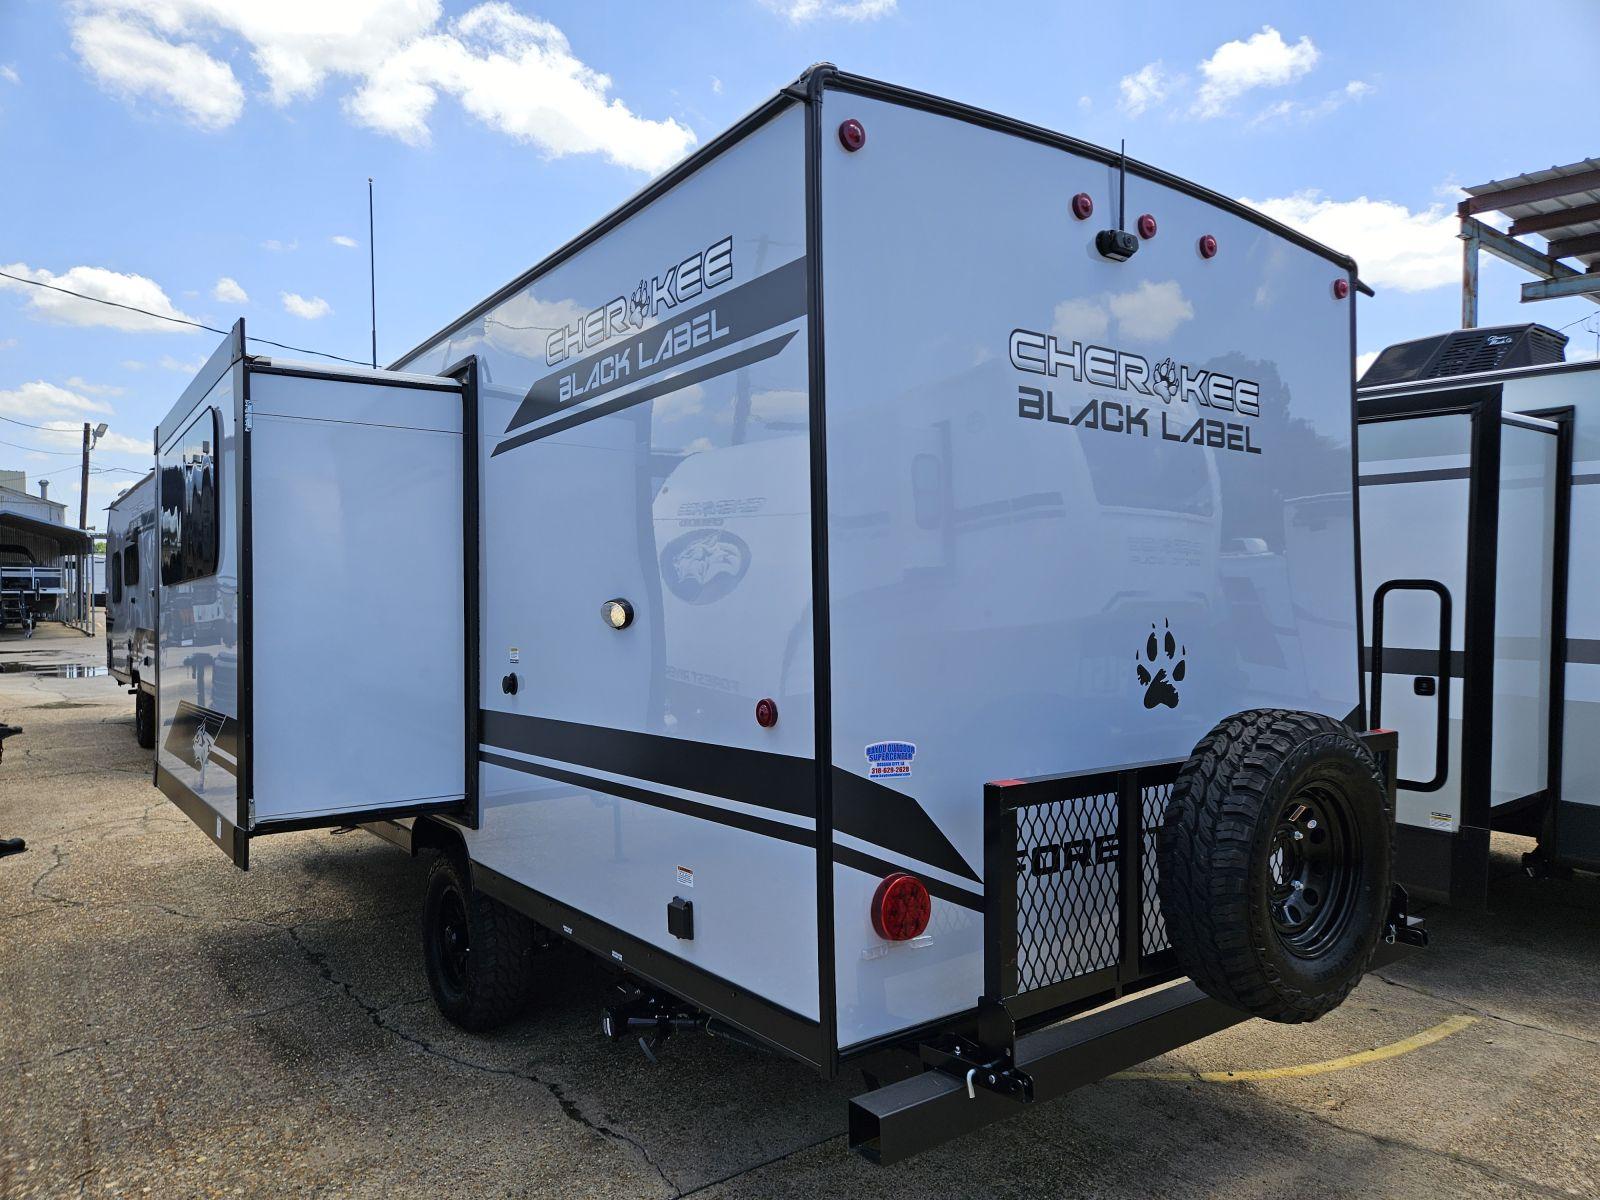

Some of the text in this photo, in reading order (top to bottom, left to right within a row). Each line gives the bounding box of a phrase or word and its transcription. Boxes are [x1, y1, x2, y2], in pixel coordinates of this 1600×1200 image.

[545, 235, 733, 367] CHERKEE
[559, 309, 729, 403] BLACK LABEL
[1008, 328, 1260, 417] CHERKEE
[1018, 385, 1262, 454] BLACK LABEL
[869, 753, 913, 762] SUPERCENTER
